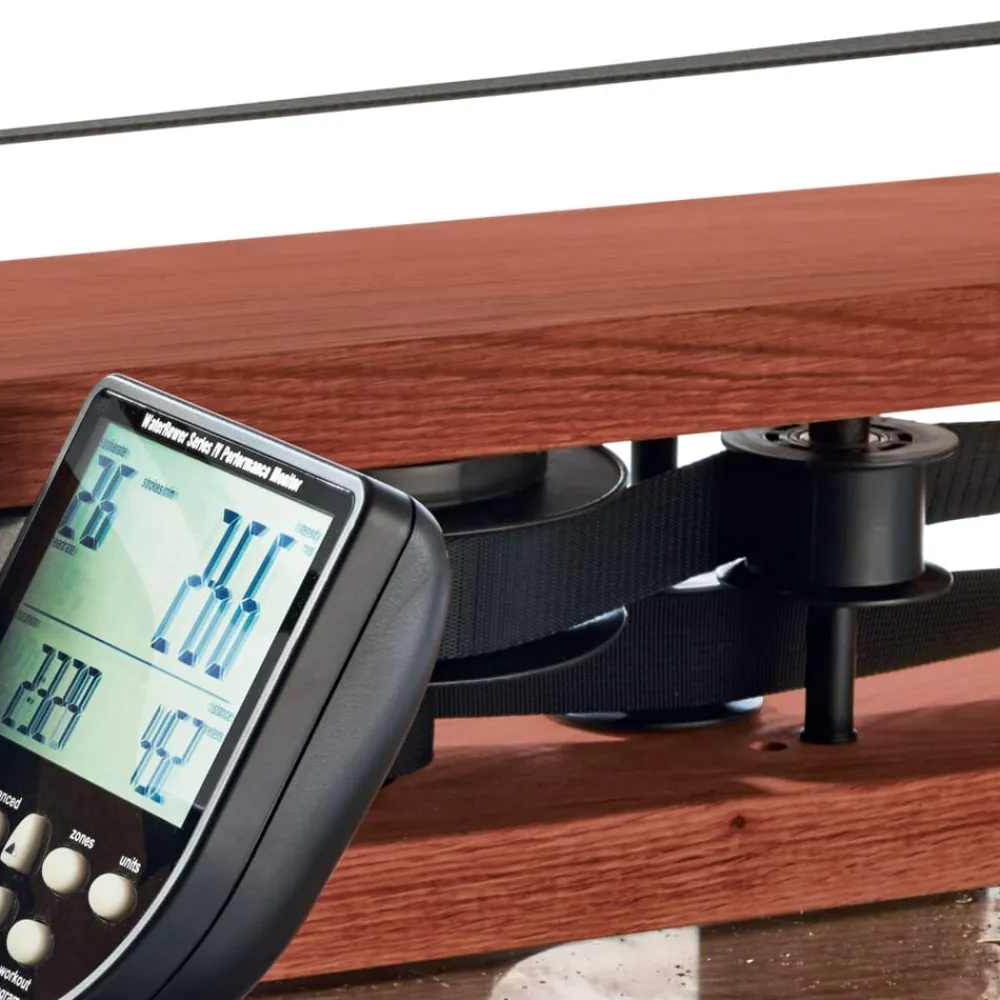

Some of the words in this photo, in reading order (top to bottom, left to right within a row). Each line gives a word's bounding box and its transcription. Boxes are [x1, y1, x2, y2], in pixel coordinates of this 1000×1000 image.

[141, 413, 188, 444] WaterRower
[187, 431, 213, 455] Series
[220, 446, 271, 480] Performance
[269, 466, 304, 493] Monitor
[69, 828, 95, 849] zones
[119, 854, 142, 874] units
